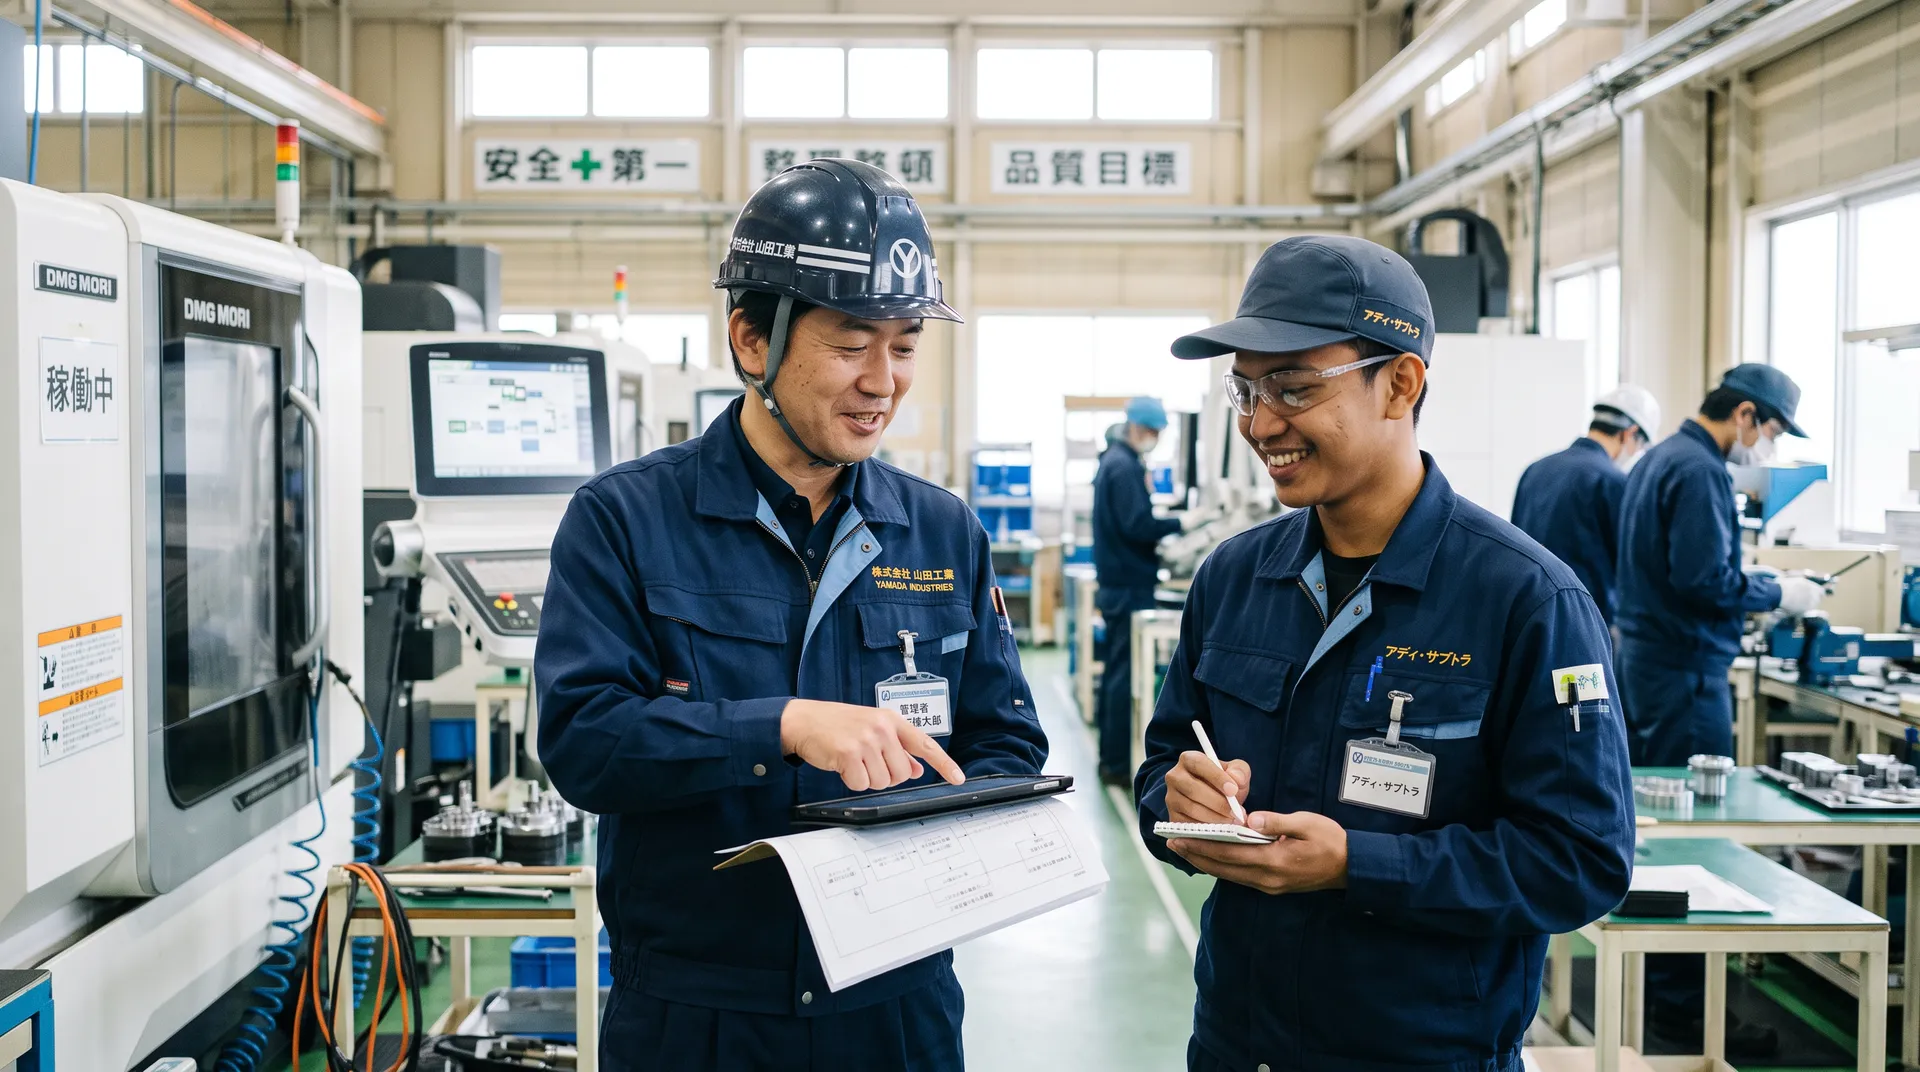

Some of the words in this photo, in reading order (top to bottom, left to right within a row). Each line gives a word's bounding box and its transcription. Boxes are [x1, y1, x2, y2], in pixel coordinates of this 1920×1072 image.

[484, 148, 561, 182] 安全
[612, 148, 688, 182] 第一
[1005, 149, 1177, 185] 品質目標
[755, 240, 796, 259] 山田工業
[46, 268, 78, 290] DMG
[78, 275, 112, 296] MORI
[184, 297, 216, 324] DMG
[217, 303, 250, 330] MORI
[46, 364, 113, 414] 稼働中
[871, 566, 912, 580] 株式会社
[913, 569, 955, 581] 山田工業
[875, 580, 908, 591] YAMADA
[909, 583, 954, 593] INDUSTRIES
[900, 702, 928, 716] 管理者
